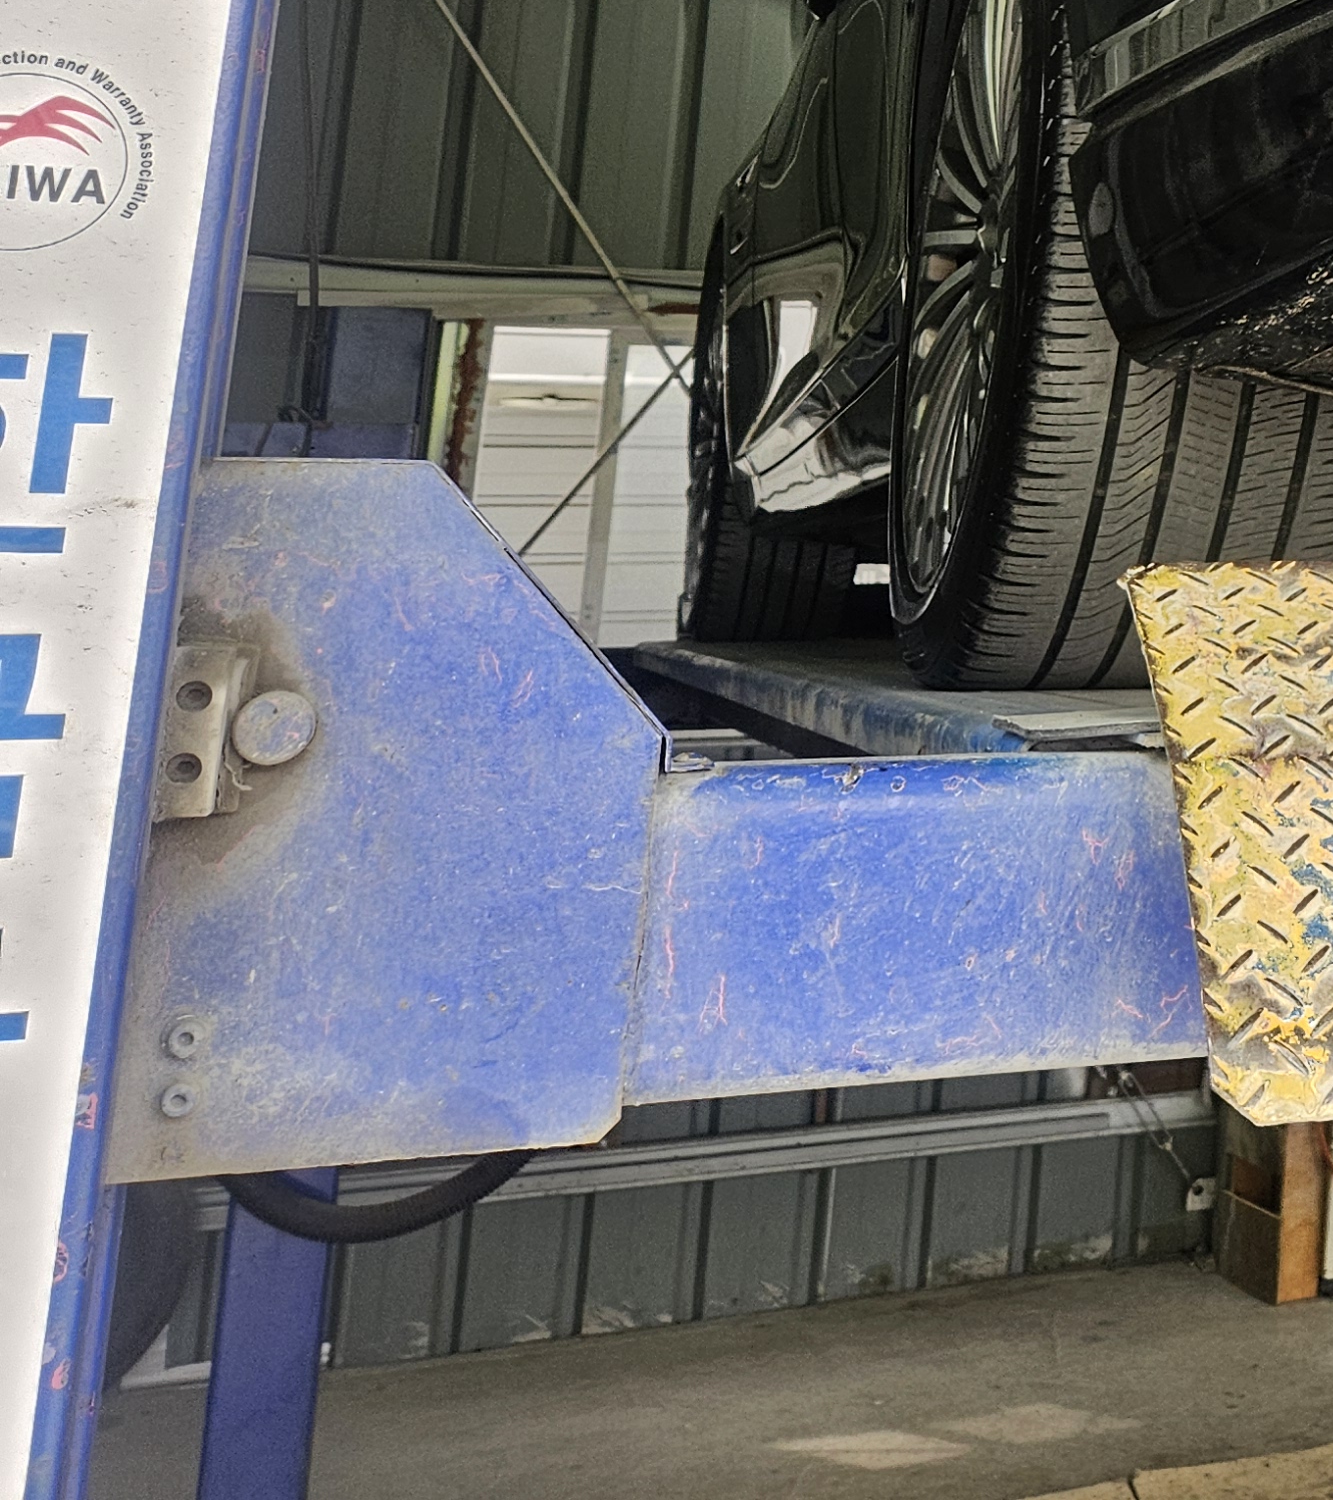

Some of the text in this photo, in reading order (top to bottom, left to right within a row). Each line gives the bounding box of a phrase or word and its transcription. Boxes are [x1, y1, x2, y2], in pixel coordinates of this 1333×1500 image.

[0, 50, 155, 220] ction and Warranty Association
